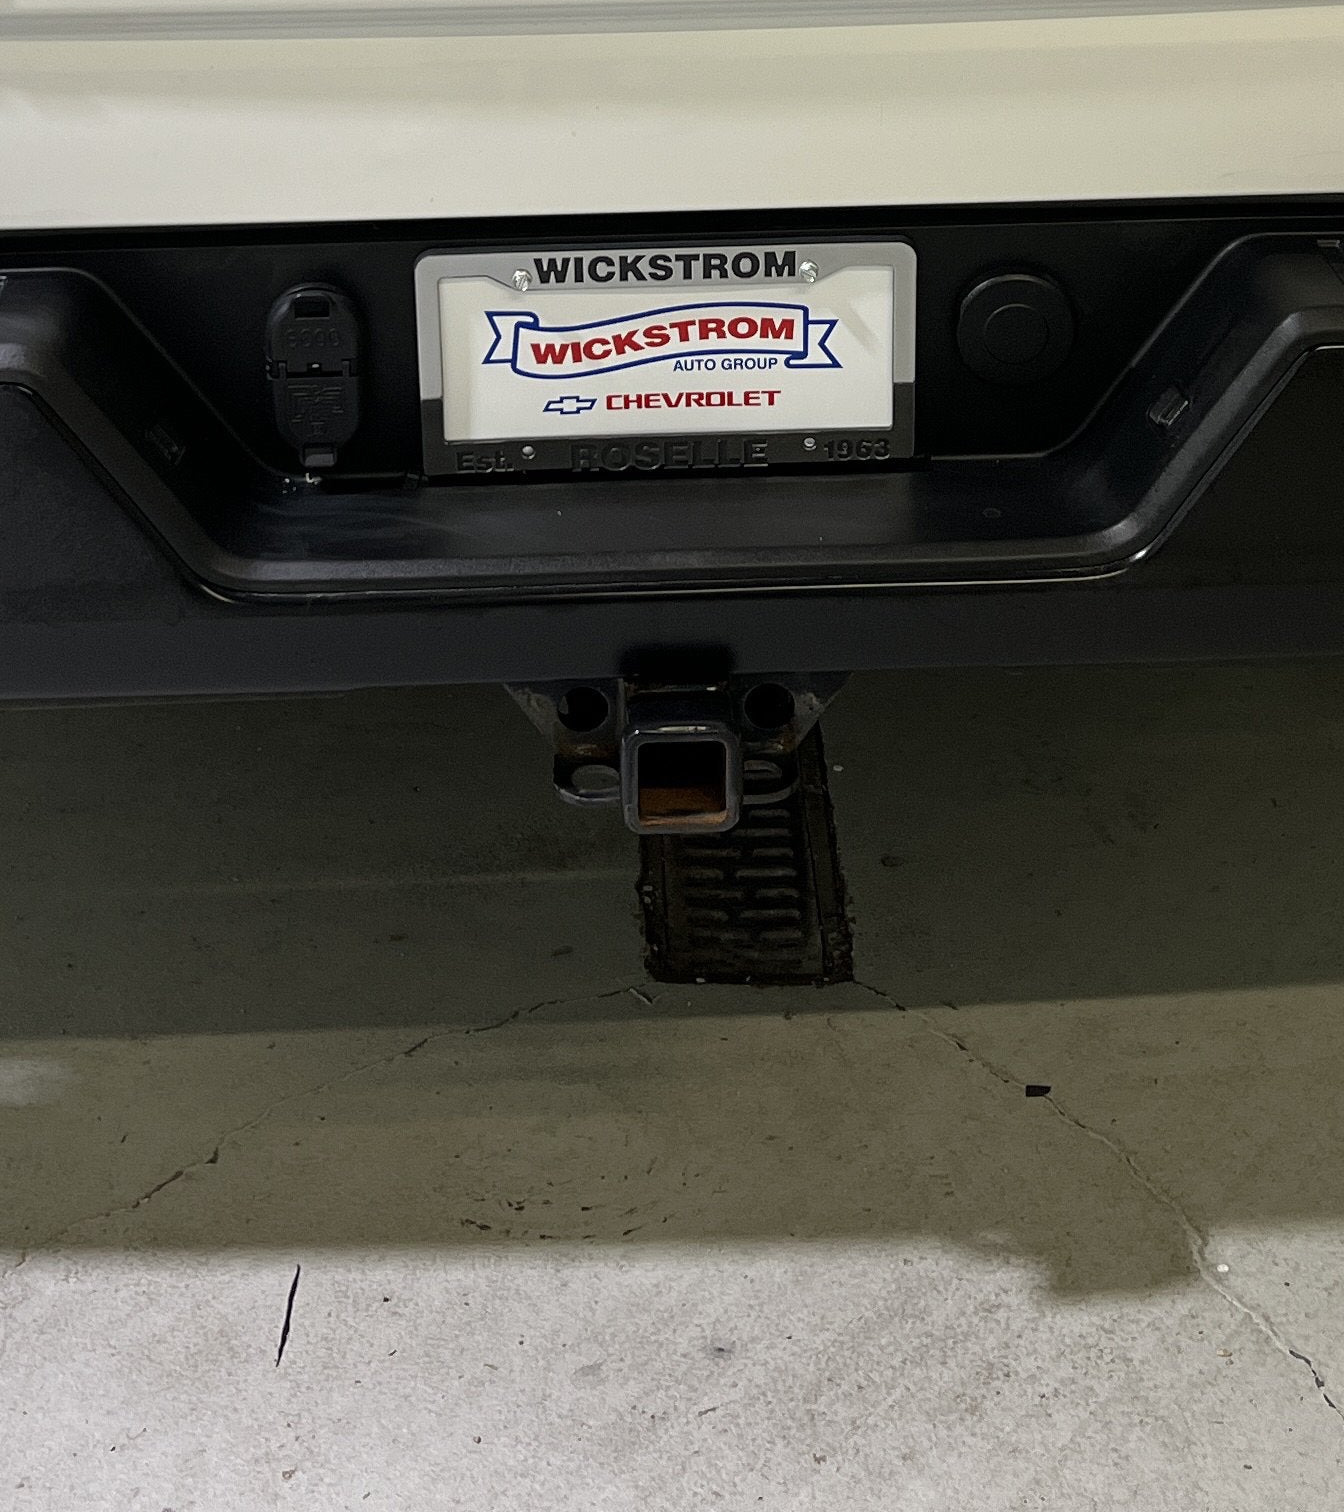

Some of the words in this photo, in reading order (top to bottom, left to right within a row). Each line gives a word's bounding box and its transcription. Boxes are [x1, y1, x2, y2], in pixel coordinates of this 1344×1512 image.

[533, 251, 797, 284] WICKSTROM
[530, 317, 795, 365] WICKSTROM
[673, 358, 717, 372] AUTO
[721, 357, 778, 371] GROUP
[605, 390, 781, 411] CHEVROLET
[456, 450, 515, 473] Est.
[570, 439, 769, 473] ROSELLE
[823, 438, 891, 462] 1963
